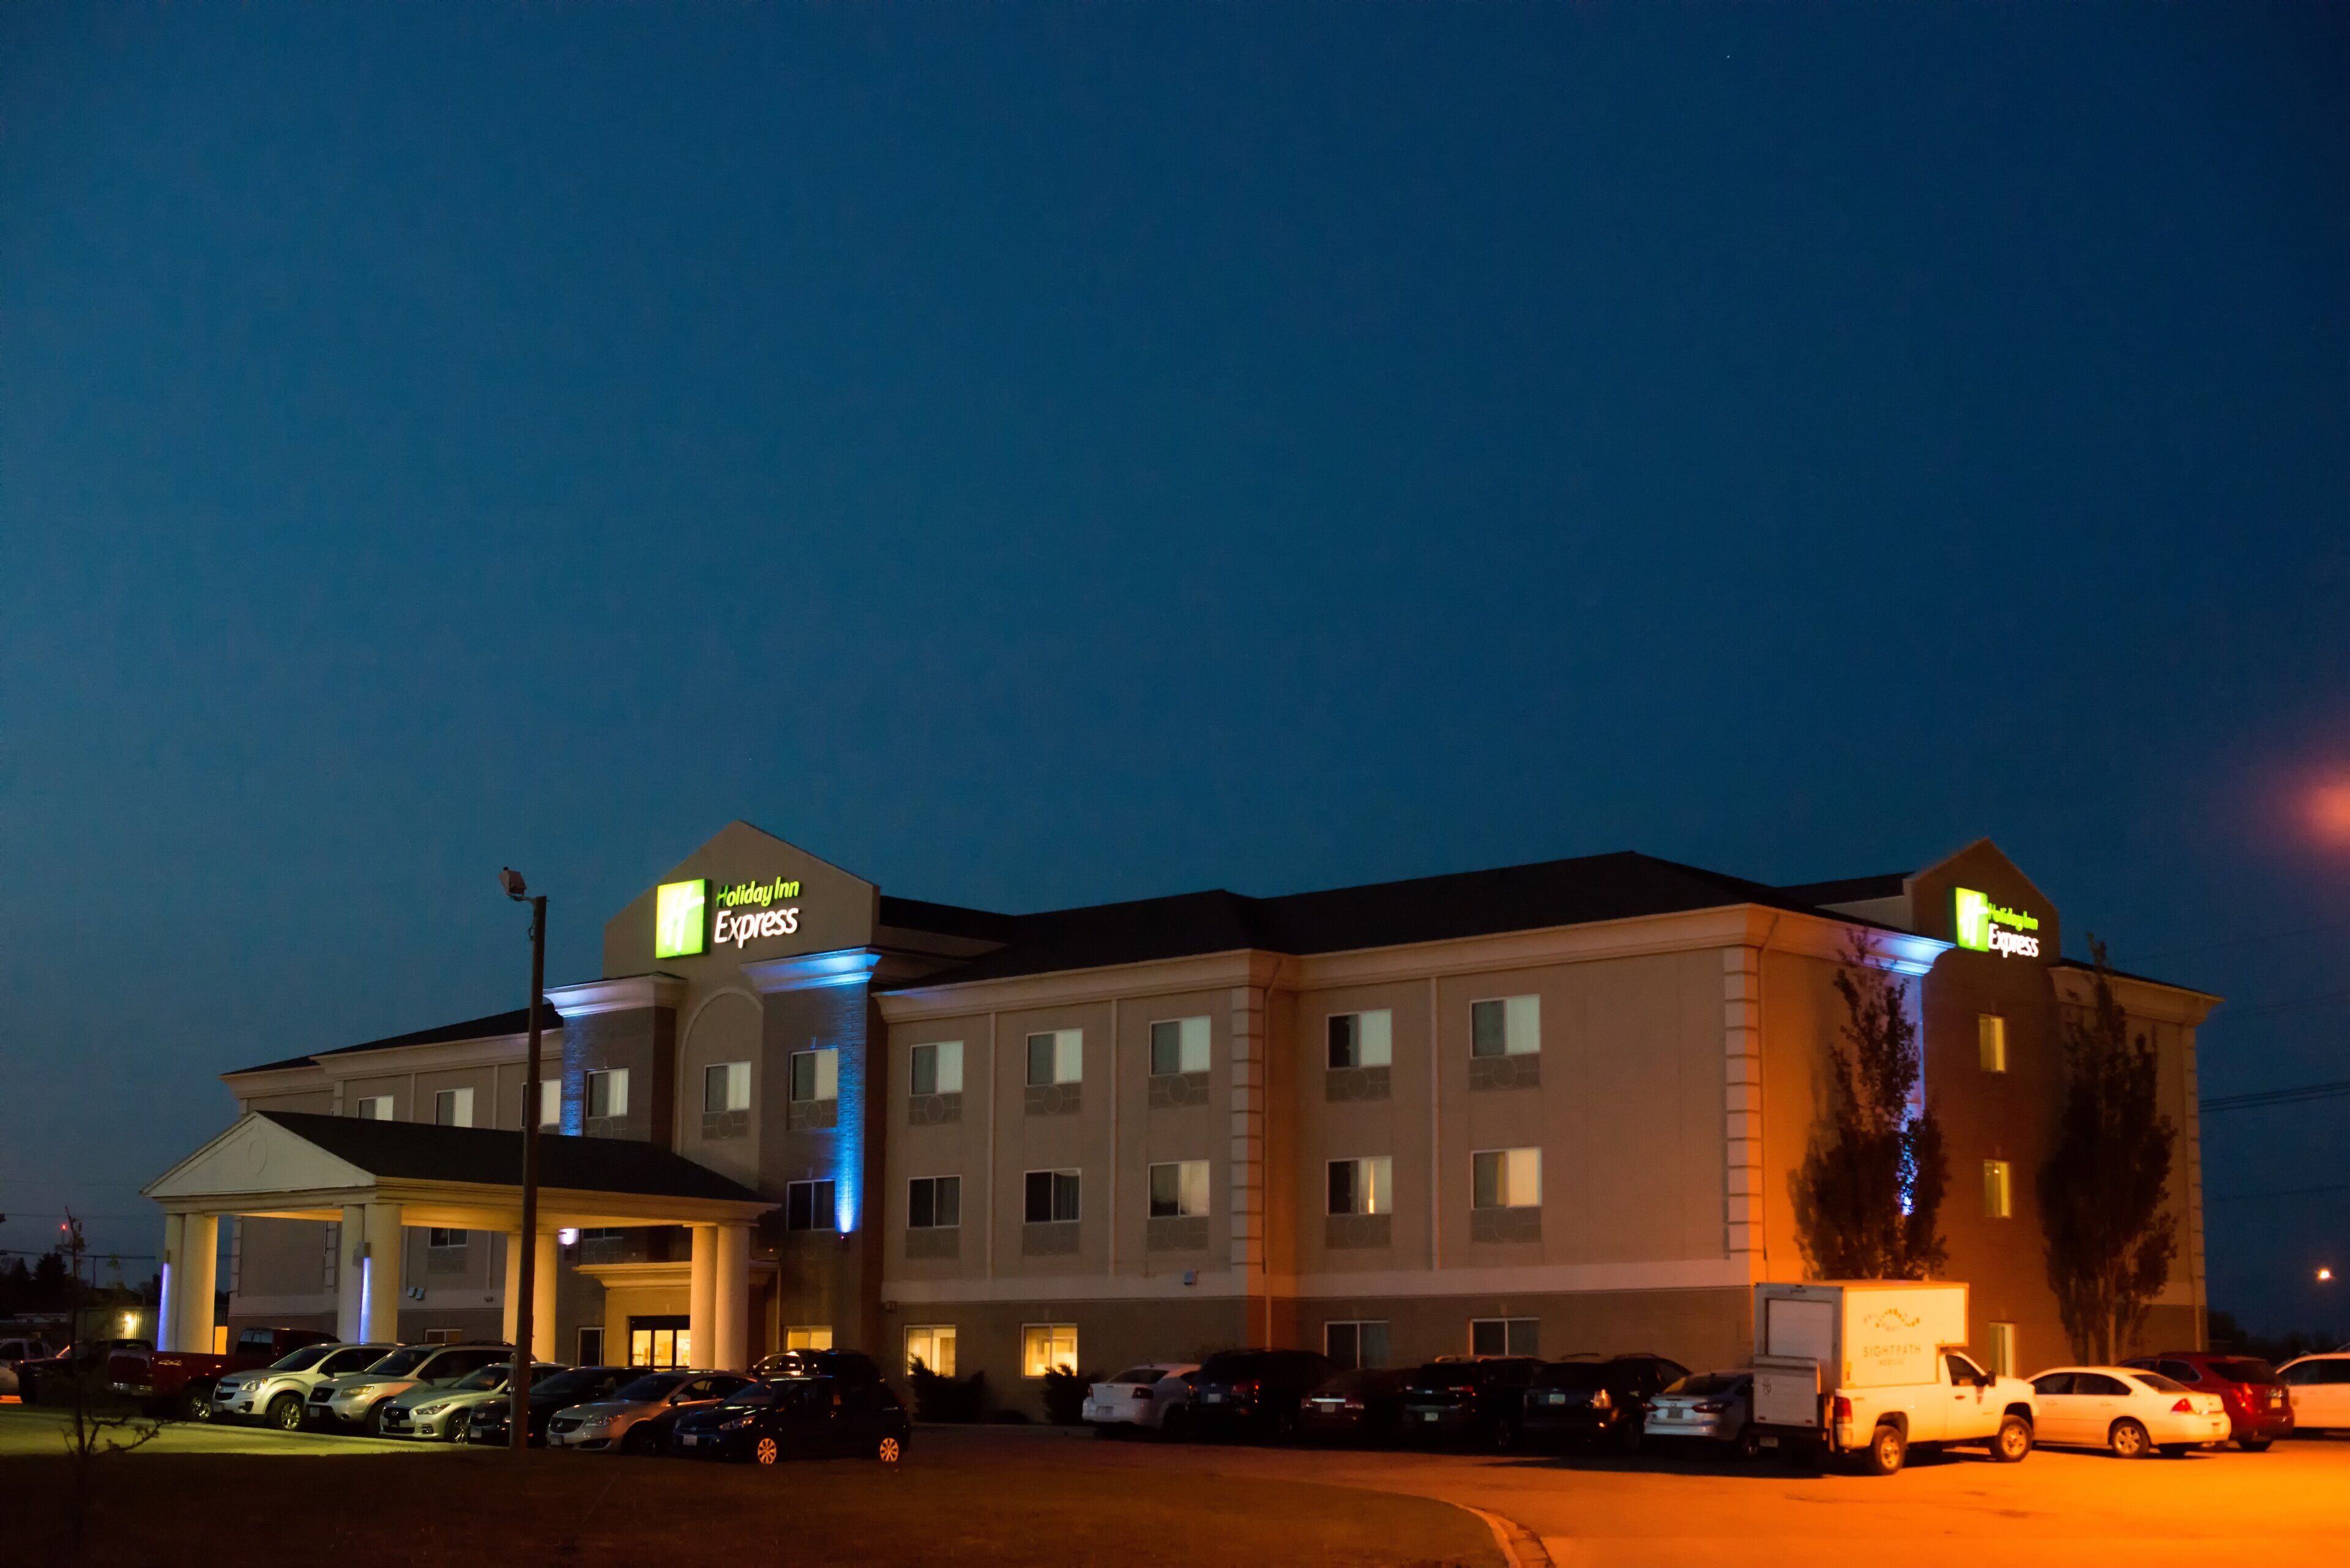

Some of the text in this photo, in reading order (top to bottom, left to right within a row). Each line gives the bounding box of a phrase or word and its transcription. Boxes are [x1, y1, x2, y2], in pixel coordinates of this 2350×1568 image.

[715, 876, 799, 907] Holiday Inn
[714, 908, 799, 949] Express
[1988, 923, 2039, 958] Express
